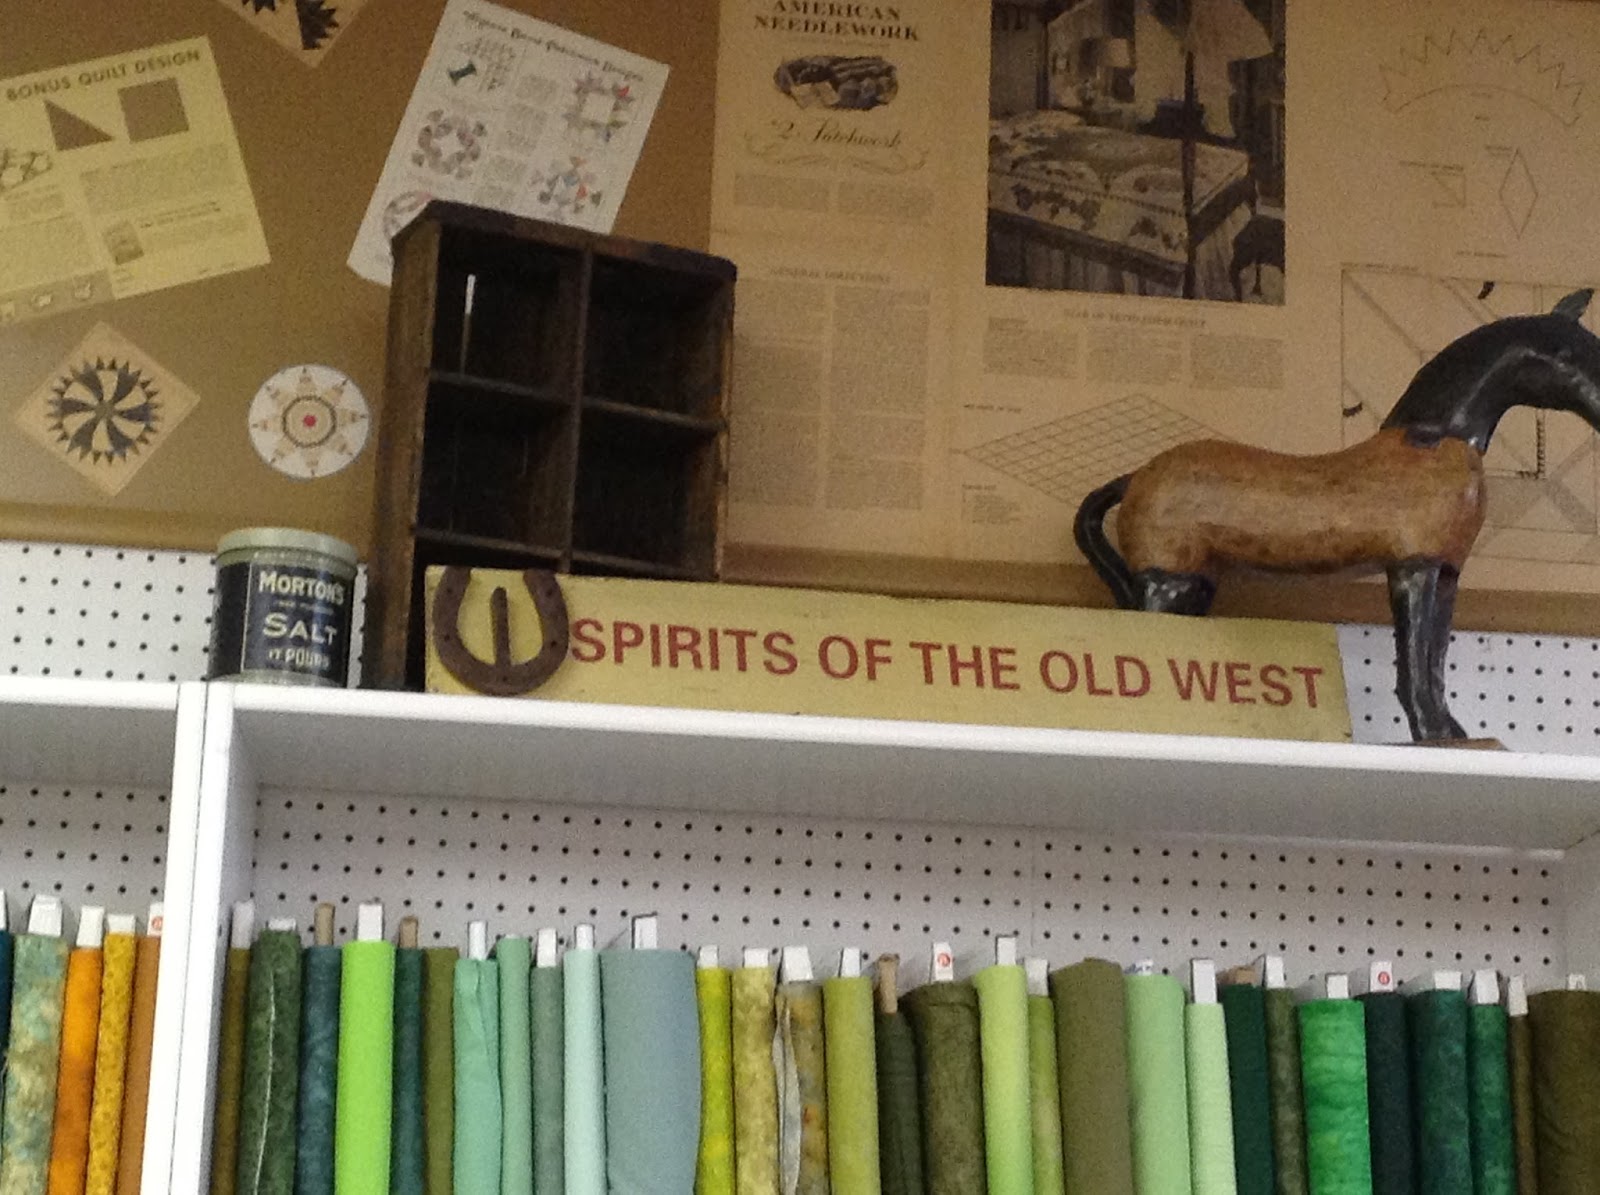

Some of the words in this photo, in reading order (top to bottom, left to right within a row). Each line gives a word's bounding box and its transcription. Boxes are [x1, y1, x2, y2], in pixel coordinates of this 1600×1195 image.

[774, 0, 900, 20] AMERICAN
[754, 14, 918, 41] NEEDLEWORK
[6, 75, 71, 101] BONUS
[78, 63, 126, 86] QUILT
[134, 49, 200, 74] DESIGN
[262, 611, 338, 645] SALT
[569, 617, 799, 677] SPIRITS
[817, 634, 893, 682] OF
[908, 639, 1021, 691] THE
[1038, 648, 1152, 699] OLD
[1165, 657, 1325, 709] WEST
